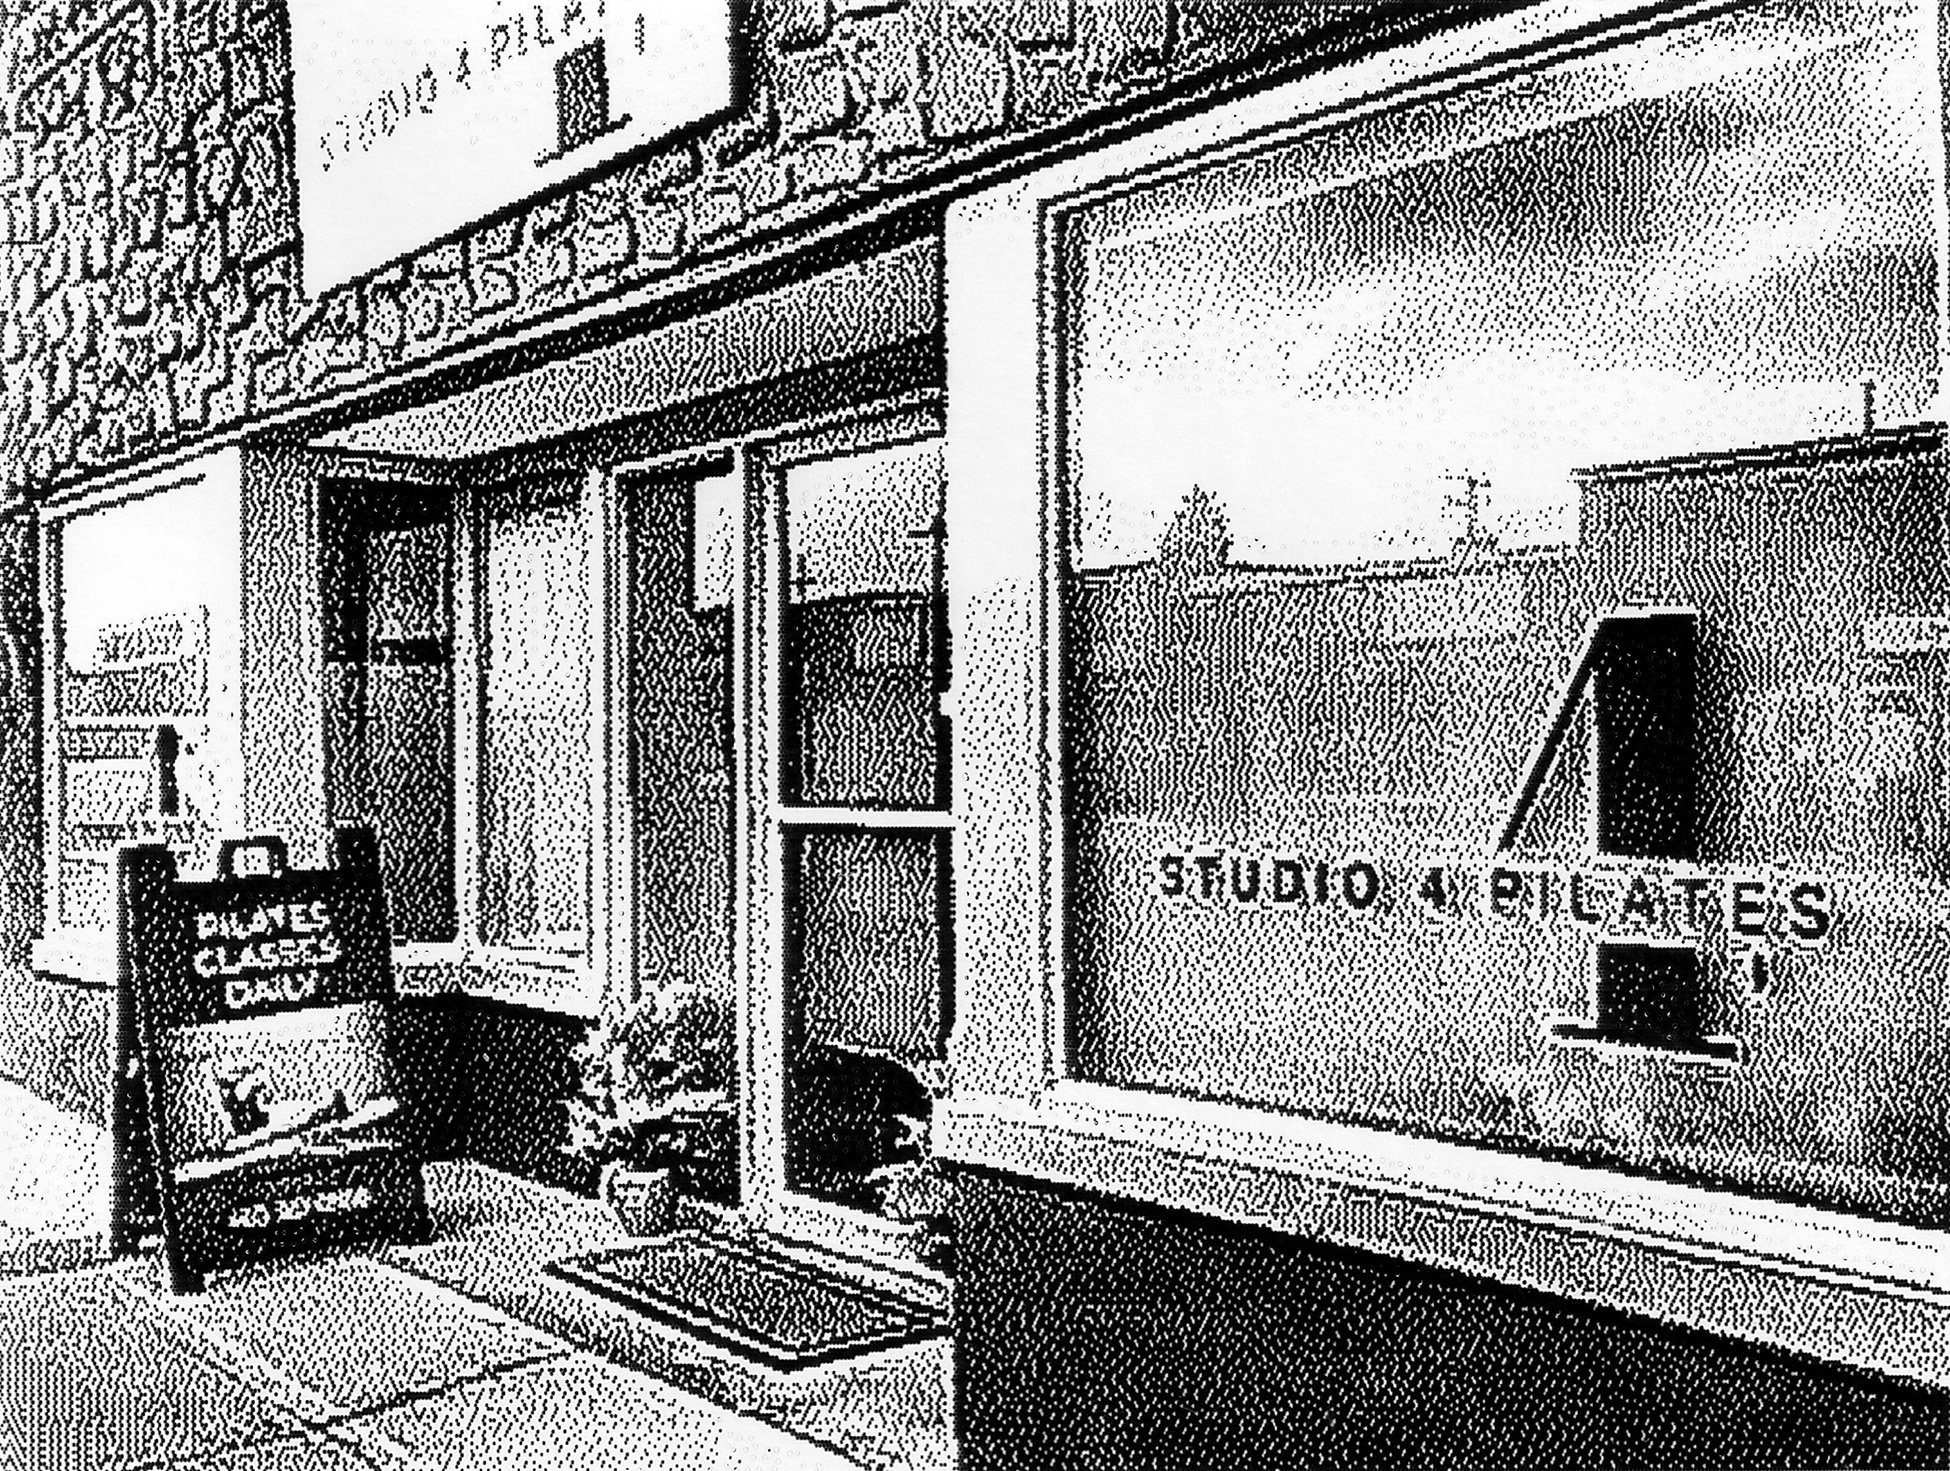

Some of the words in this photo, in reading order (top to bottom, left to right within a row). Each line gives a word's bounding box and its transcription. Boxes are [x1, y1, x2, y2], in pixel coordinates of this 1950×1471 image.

[321, 63, 438, 172] STUDIO
[195, 901, 330, 940] PILATES
[1159, 855, 1381, 910] STUDIO
[1419, 866, 1449, 910] 4
[1491, 866, 1831, 941] PILATES
[194, 933, 344, 978] CLASSES
